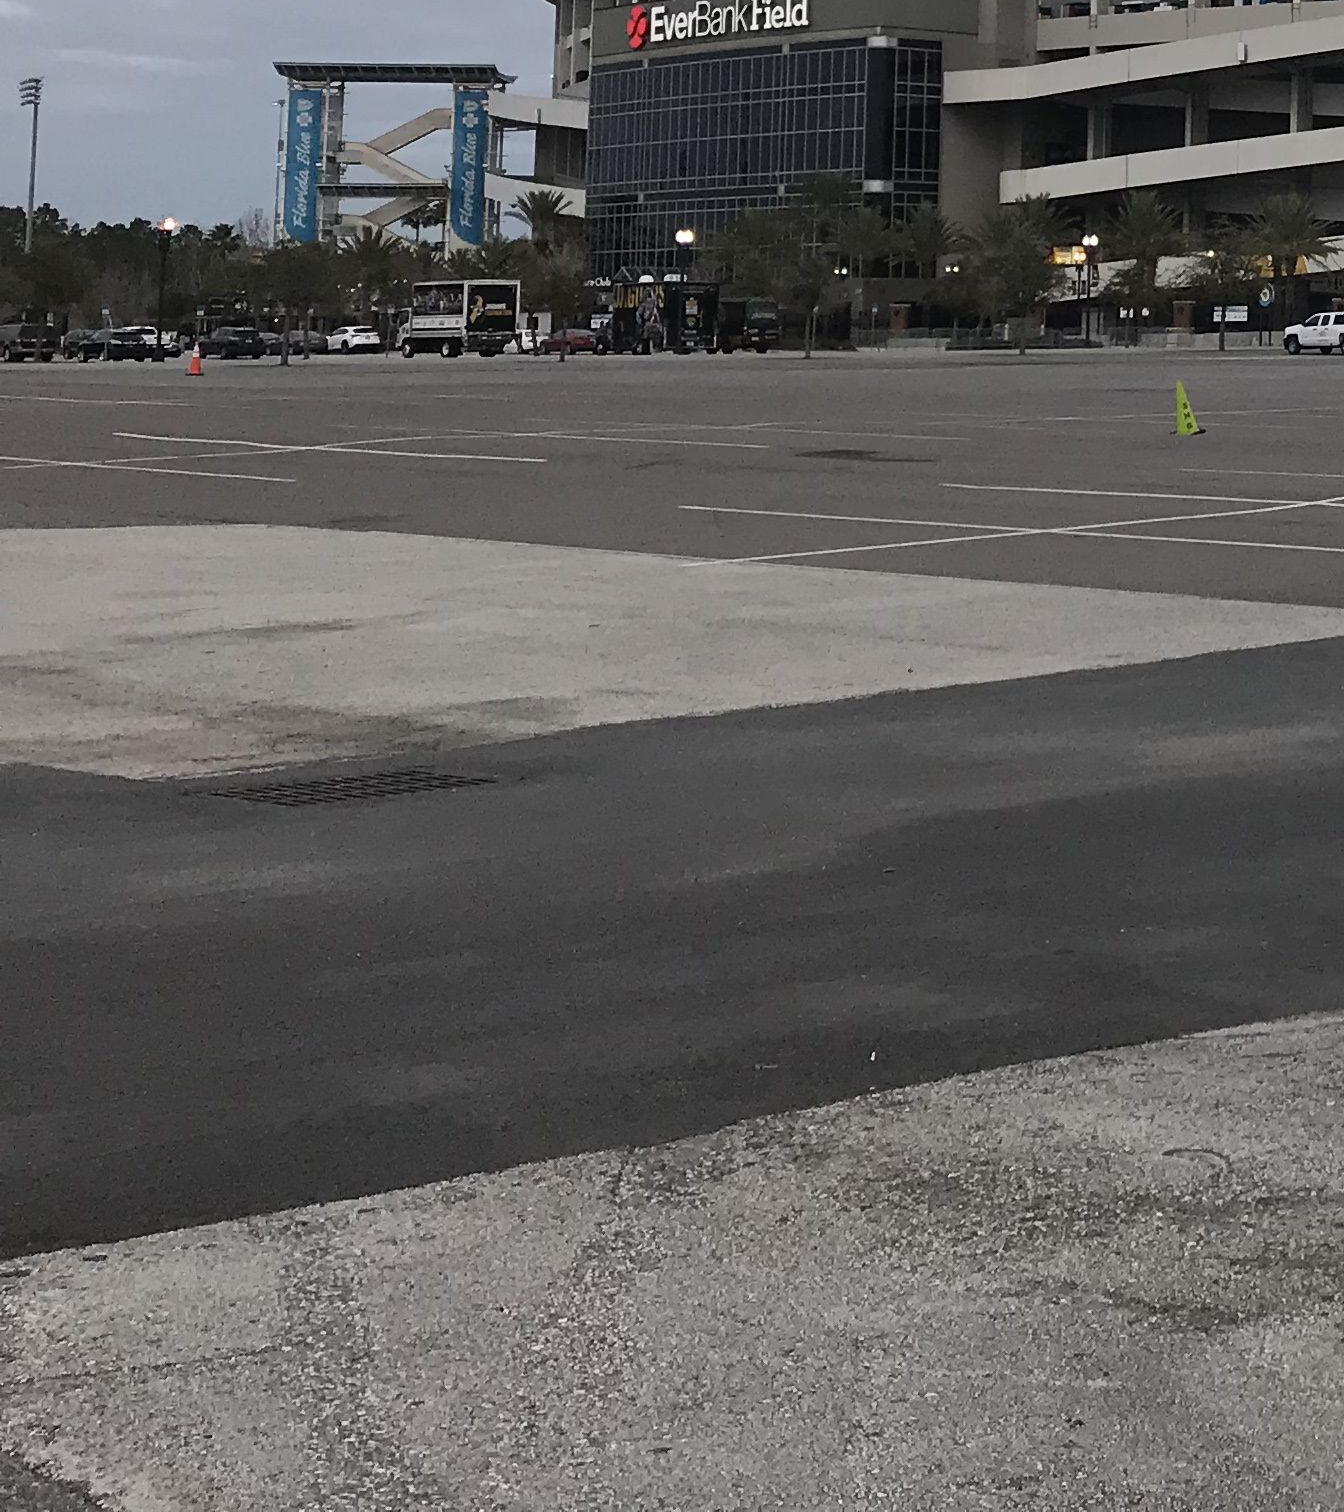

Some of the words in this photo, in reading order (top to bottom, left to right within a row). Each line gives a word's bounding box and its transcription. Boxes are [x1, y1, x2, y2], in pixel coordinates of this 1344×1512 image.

[295, 132, 311, 166] Blue
[462, 132, 477, 166] Blue
[292, 168, 309, 228] Florida
[459, 169, 475, 228] Florida
